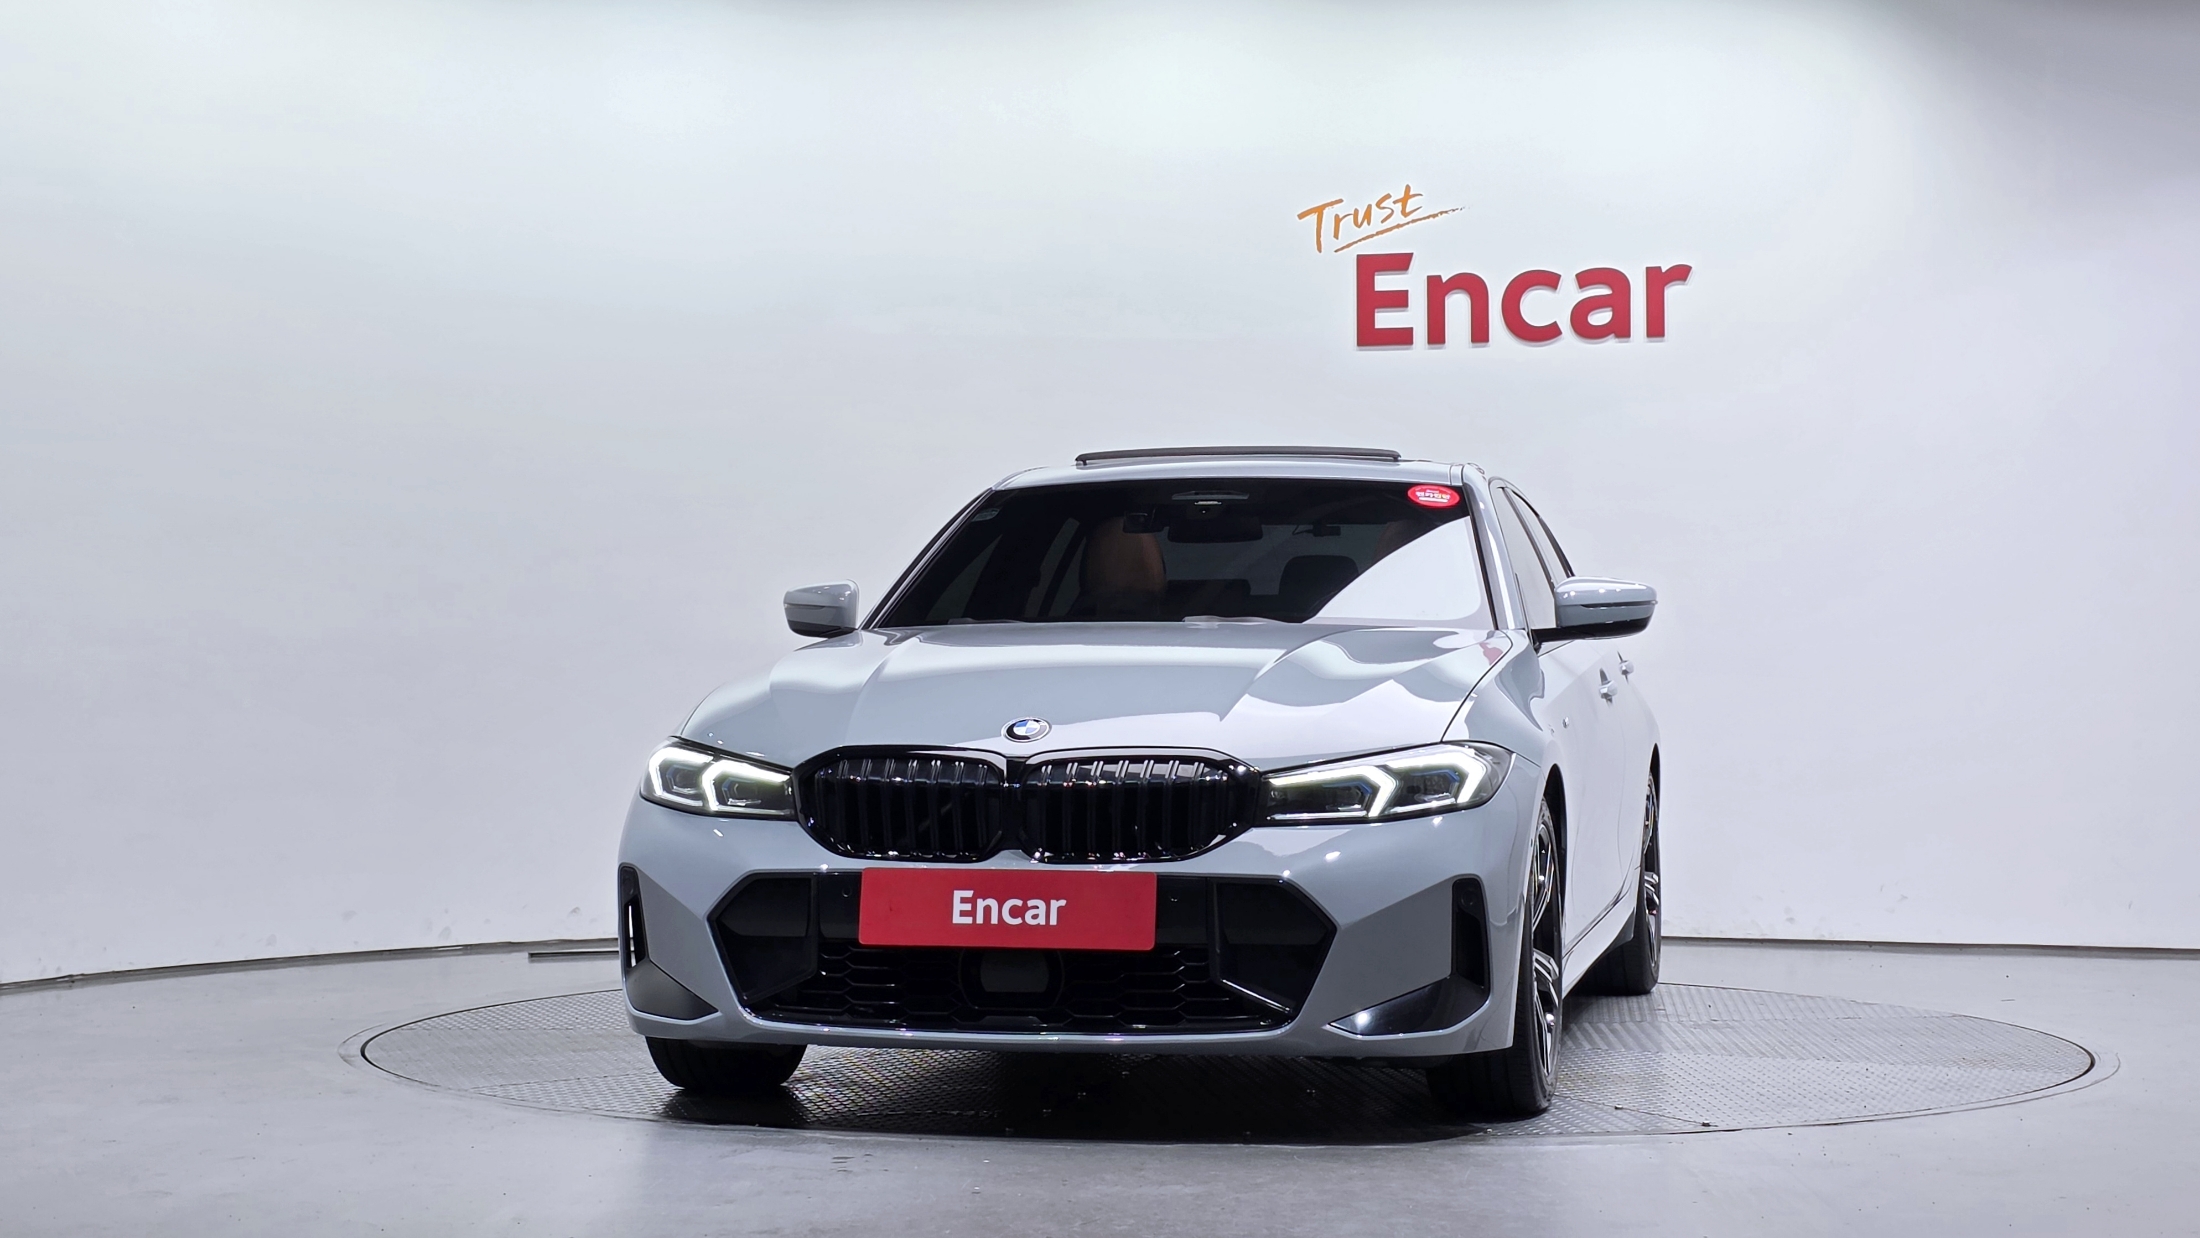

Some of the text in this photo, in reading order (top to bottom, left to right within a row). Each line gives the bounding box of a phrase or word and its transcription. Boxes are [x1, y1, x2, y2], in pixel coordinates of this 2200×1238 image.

[1297, 184, 1424, 253] Trust
[1356, 252, 1693, 347] Encar
[952, 889, 1067, 926] Encar
